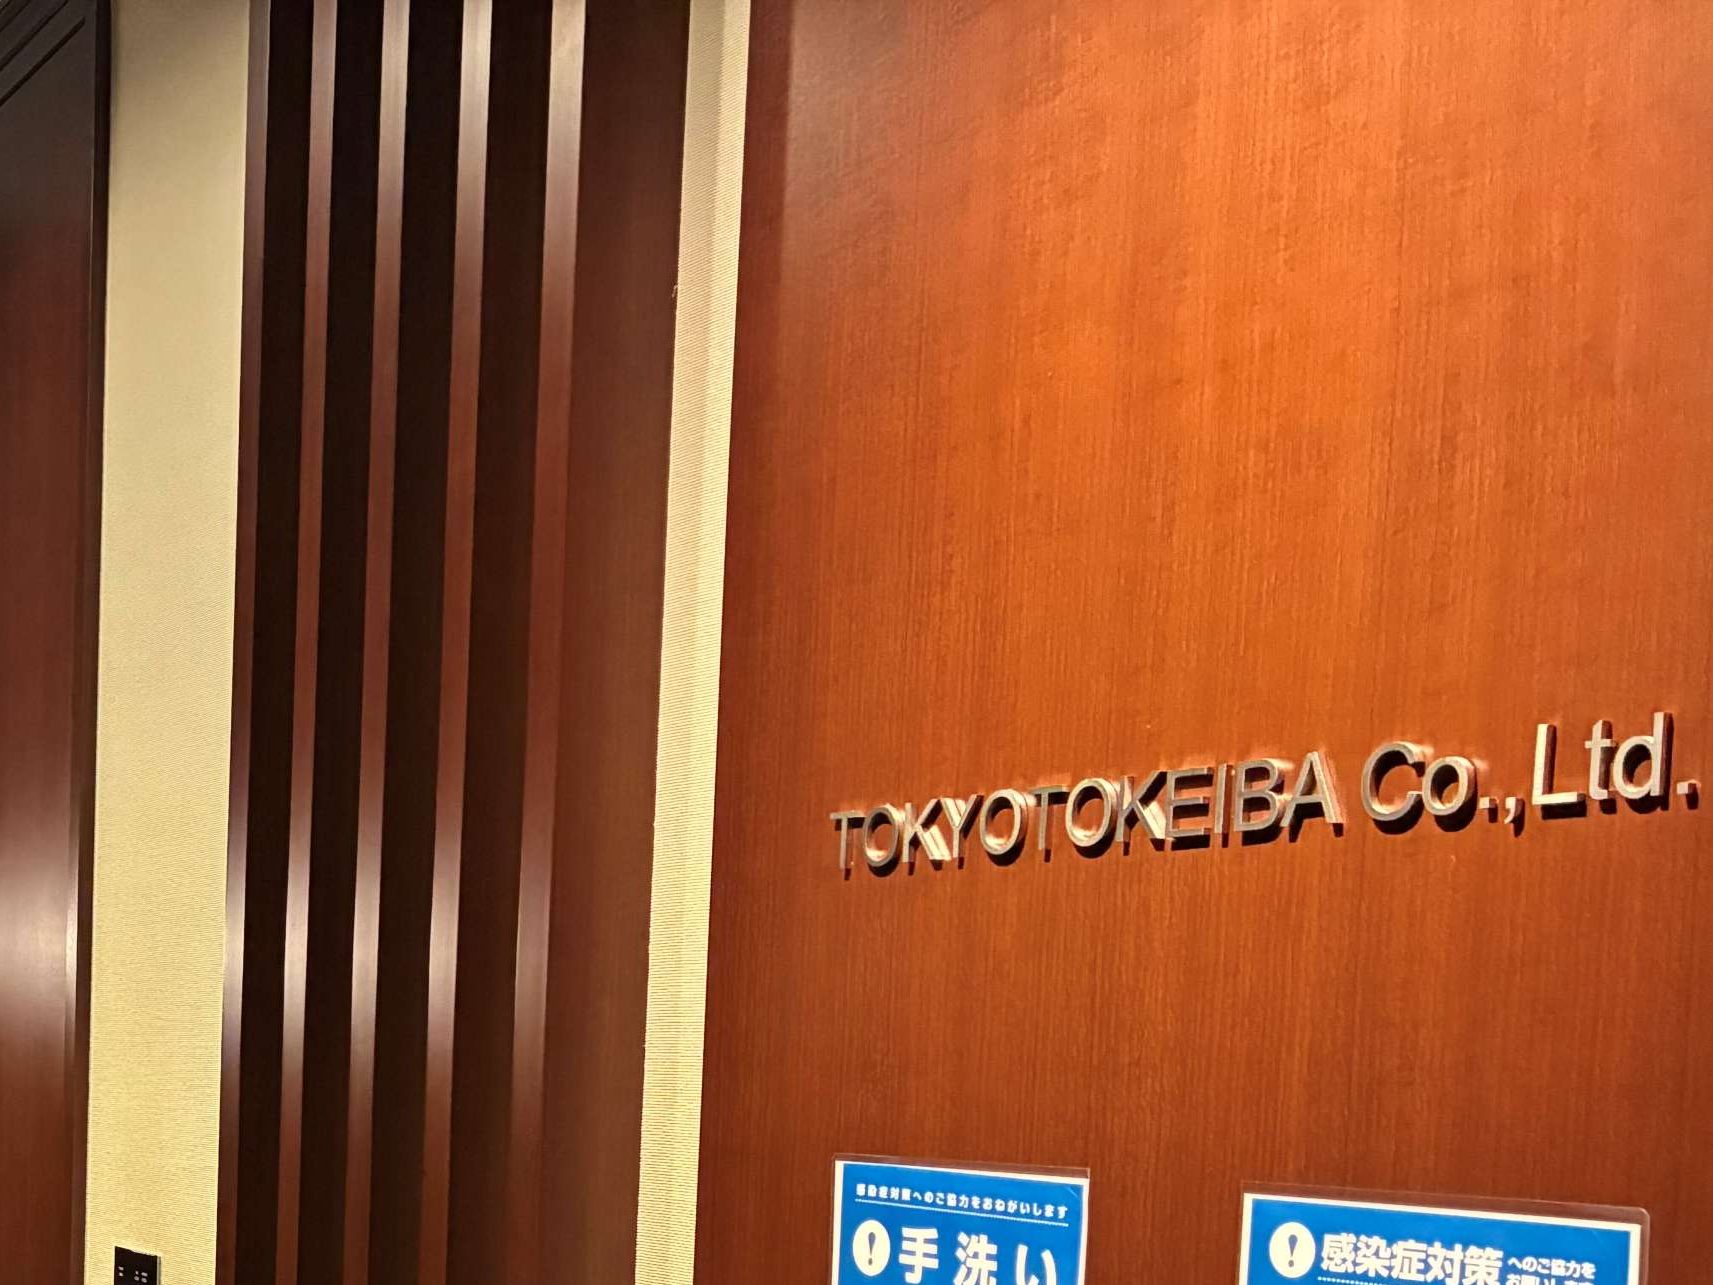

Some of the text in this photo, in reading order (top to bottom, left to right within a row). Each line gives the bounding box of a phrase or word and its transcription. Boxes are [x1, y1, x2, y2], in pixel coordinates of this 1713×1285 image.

[830, 711, 1697, 868] TOKYOTOKEIBA Co.,Ltd.
[1507, 1256, 1596, 1280] へのご協力を
